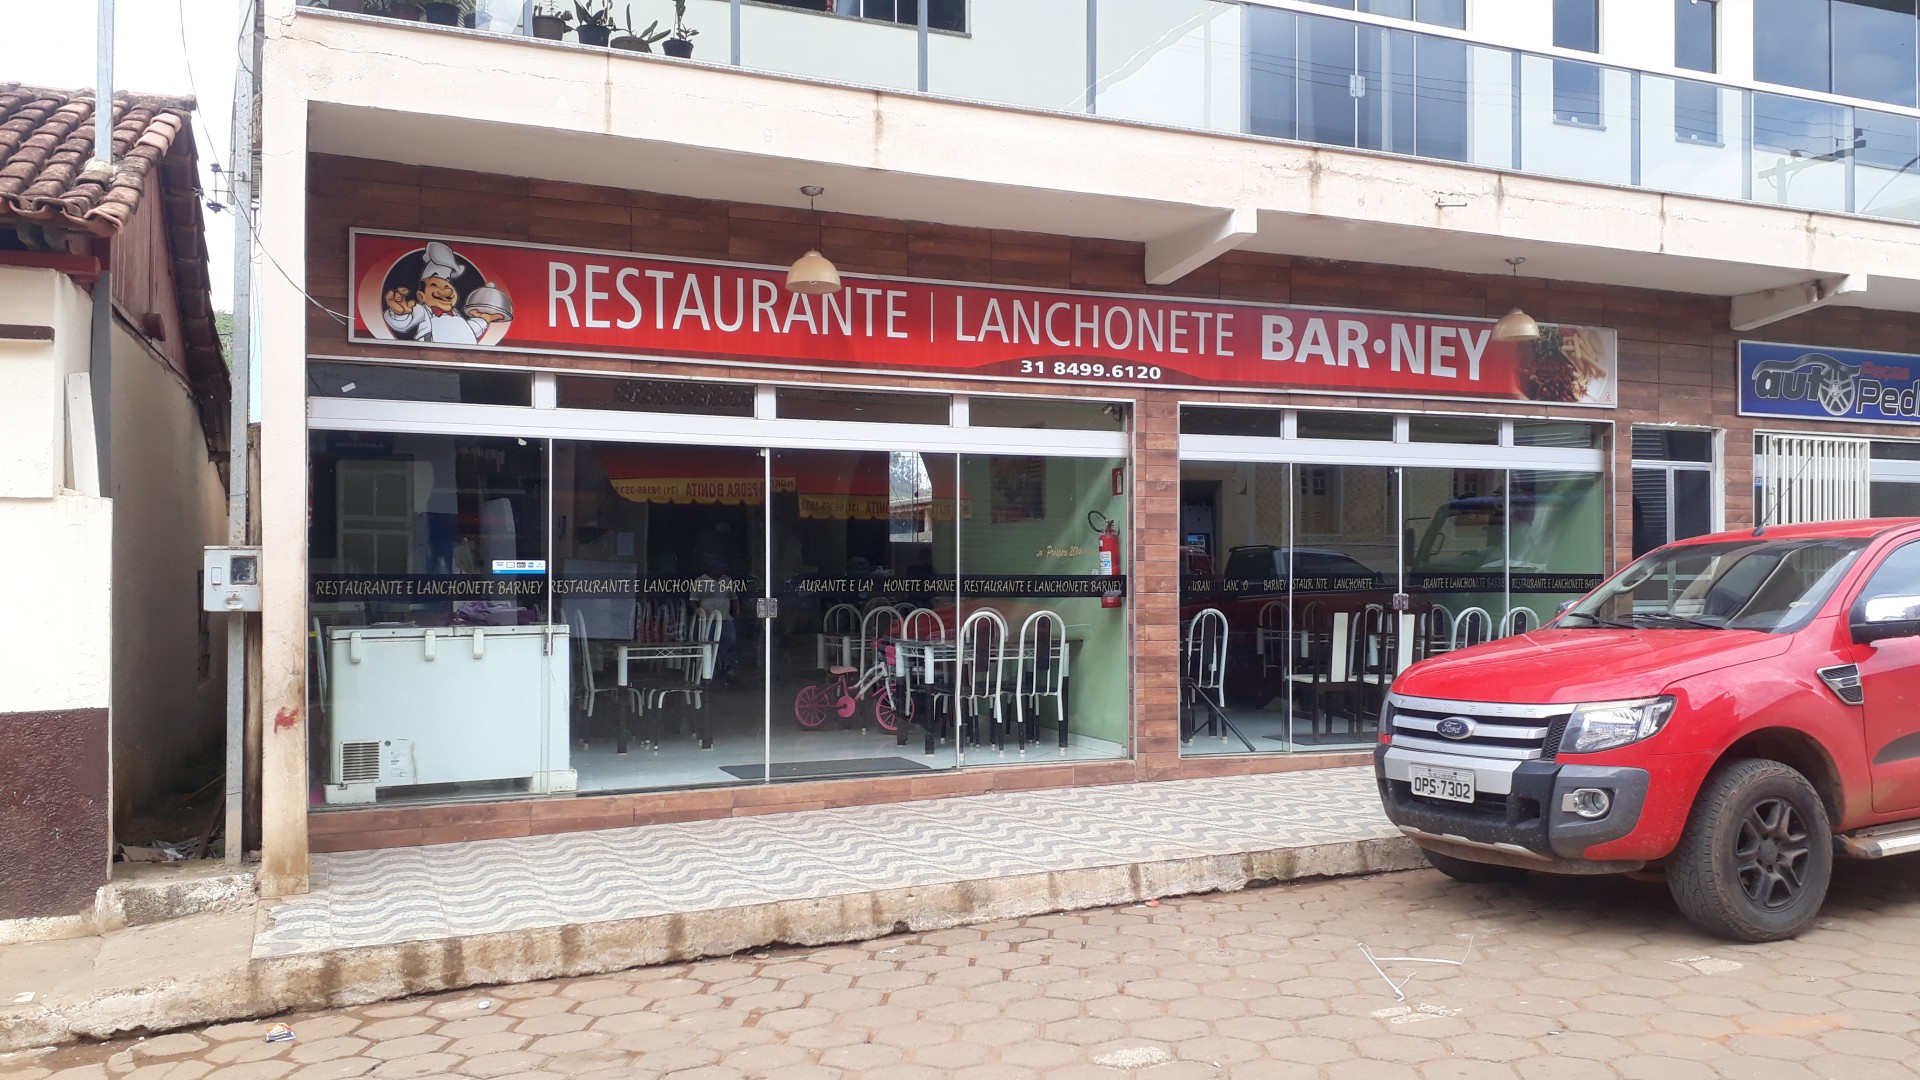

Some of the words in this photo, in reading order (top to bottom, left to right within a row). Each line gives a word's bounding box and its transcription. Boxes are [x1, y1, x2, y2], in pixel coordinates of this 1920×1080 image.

[548, 261, 908, 339] RESTAURANTE
[956, 295, 1234, 357] LANCHONETE
[1020, 360, 1045, 374] 31
[1053, 361, 1162, 380] 8499.6120
[1856, 379, 1920, 417] Ped
[315, 580, 403, 595] RESTAURANTE
[406, 580, 414, 594] E
[417, 579, 495, 595] LANCHONETE
[498, 580, 544, 595] BARNEY
[551, 579, 631, 593] RESTAURANTE
[634, 579, 640, 593] E
[644, 578, 716, 593] LANCHONETE
[850, 579, 855, 592] E
[924, 579, 957, 592] BARNE
[963, 580, 1025, 593] RESTAURANTE
[1027, 580, 1032, 592] E
[1034, 579, 1089, 593] LANCHONETE
[1090, 580, 1123, 593] BARNEY
[1263, 578, 1287, 591] BARNEY
[1333, 578, 1373, 590] LANCHONETE
[1441, 720, 1462, 734] Ford
